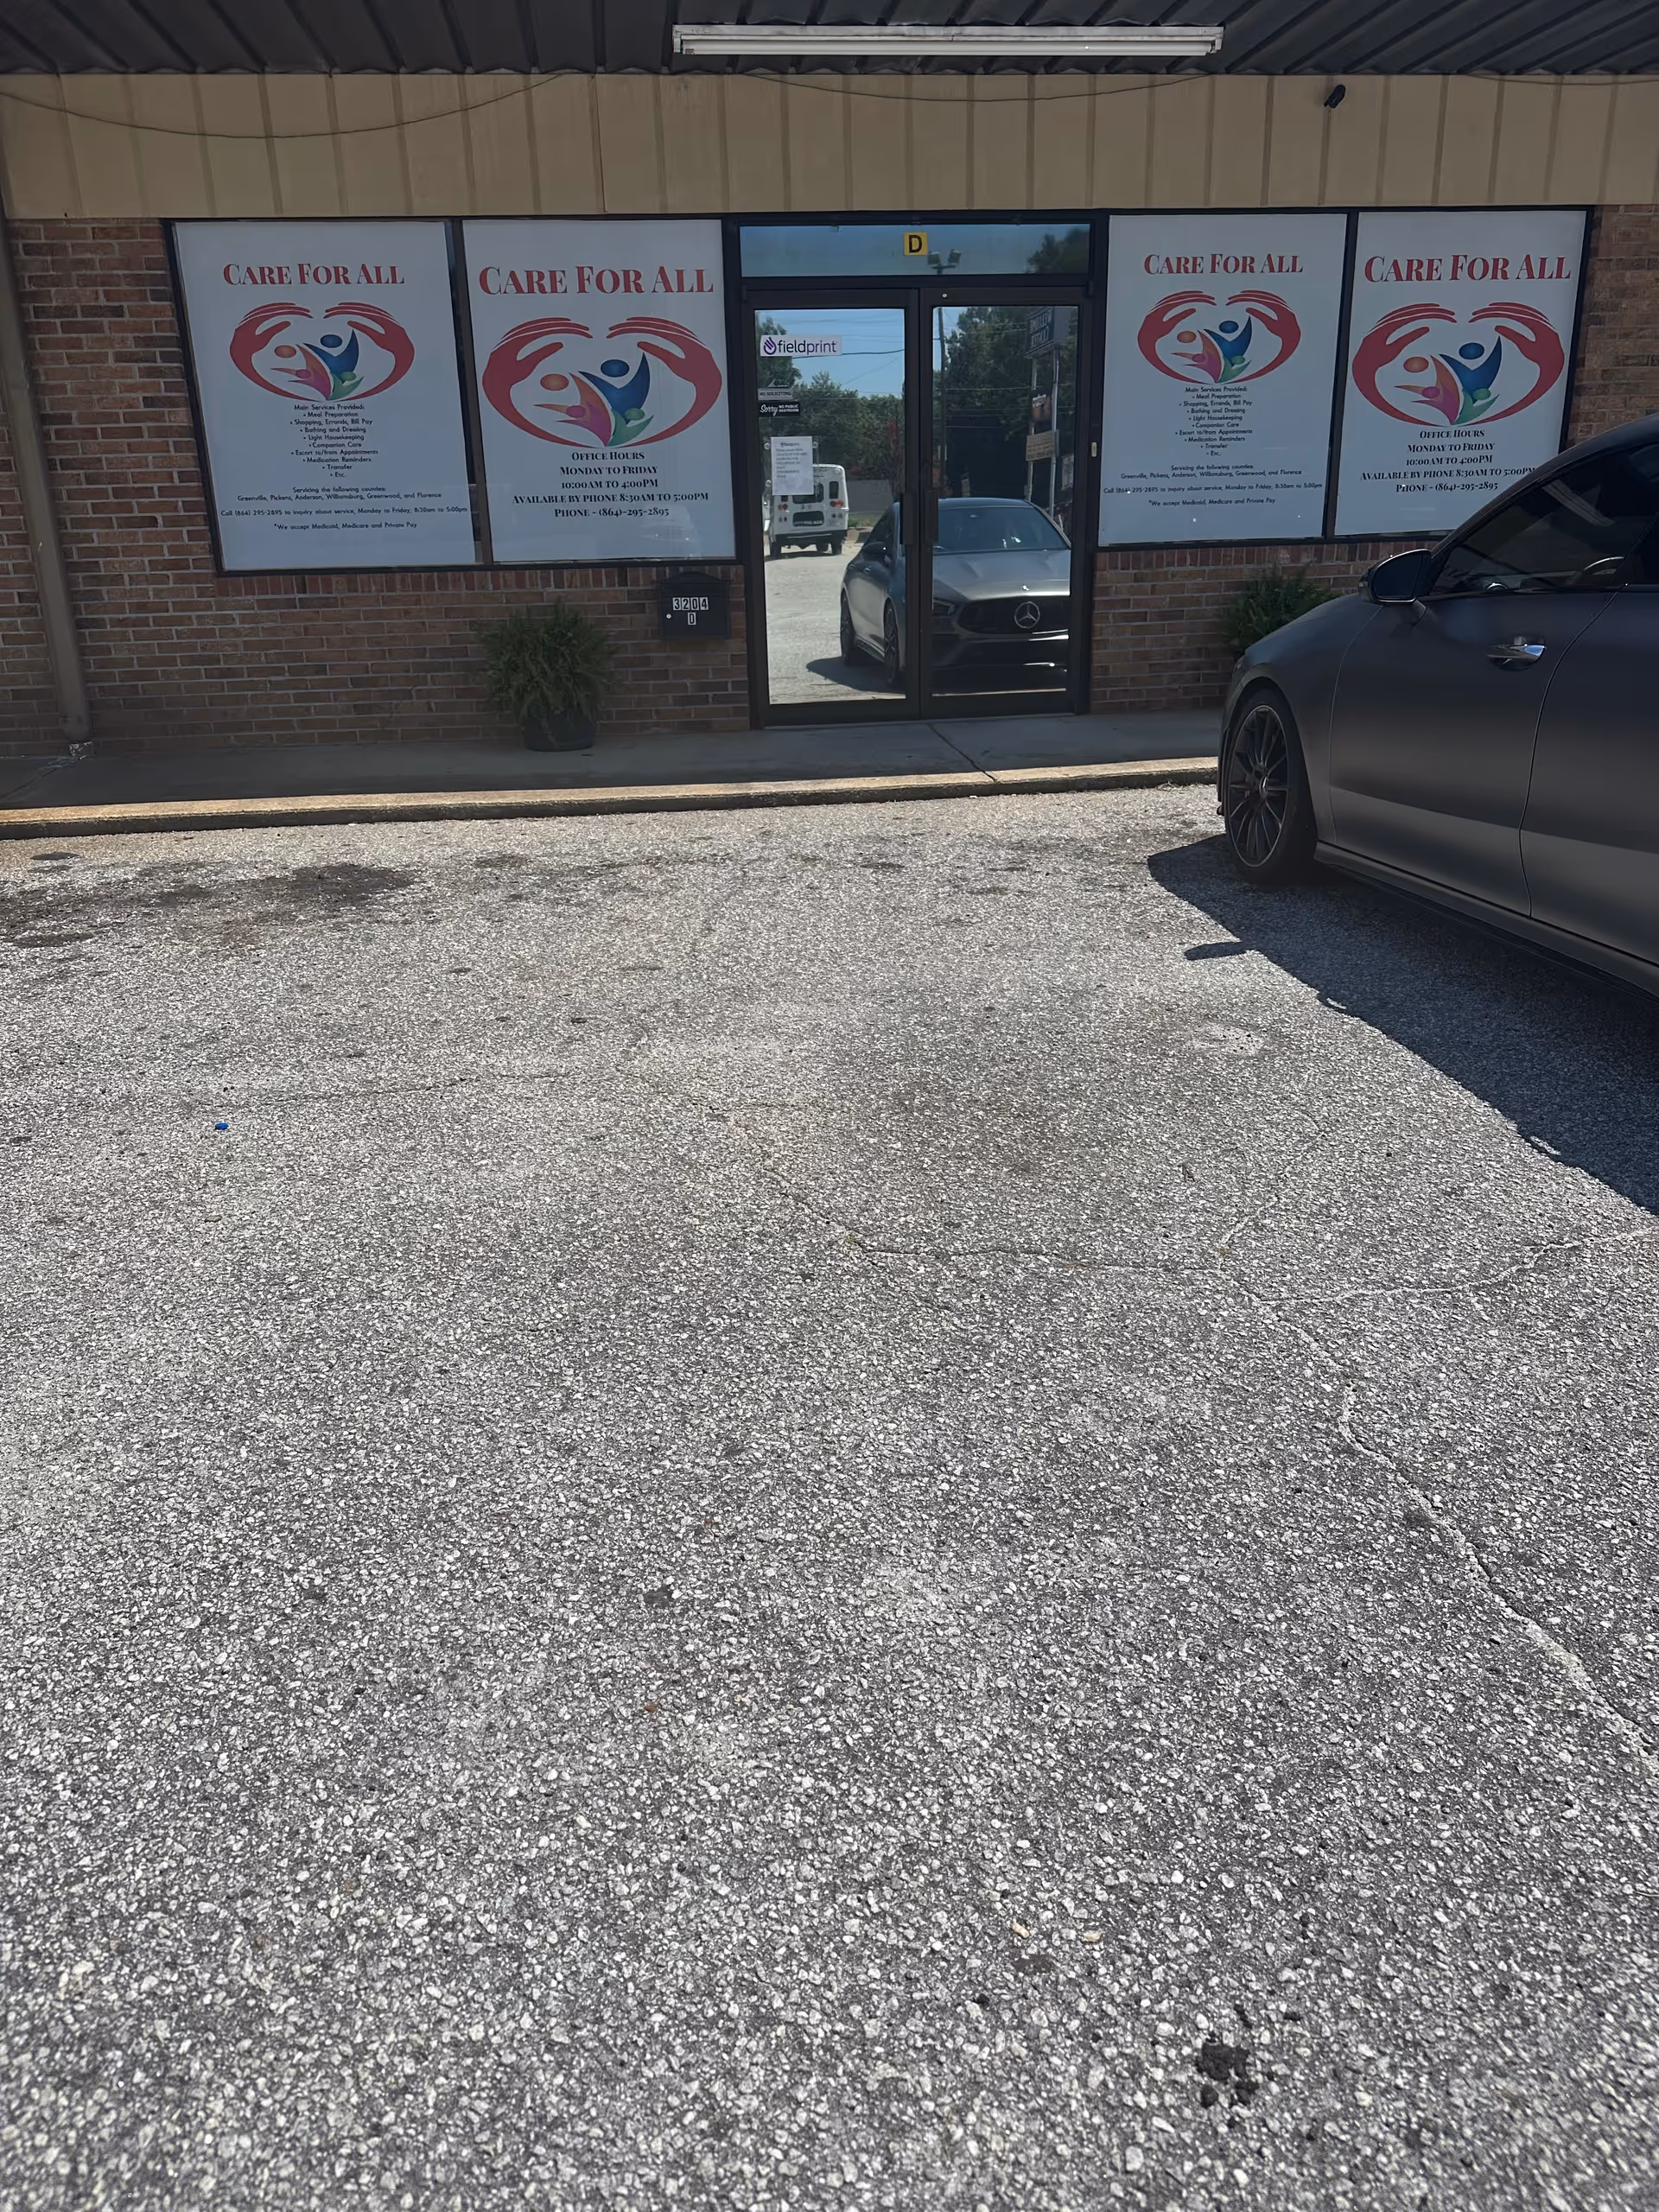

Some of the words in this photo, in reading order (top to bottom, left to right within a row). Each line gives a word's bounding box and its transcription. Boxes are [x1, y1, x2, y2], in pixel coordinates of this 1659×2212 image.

[909, 235, 922, 253] D
[1144, 254, 1204, 275] CARE
[1210, 254, 1255, 274] FOR
[1260, 253, 1303, 273] ALL
[1365, 257, 1442, 283] CARE
[1449, 255, 1510, 281] FOR
[1515, 254, 1571, 279] ALL
[224, 264, 291, 285] CARE
[297, 264, 351, 284] FOR
[357, 264, 404, 284] ALL
[480, 267, 567, 295] CARE
[575, 266, 645, 294] FOR
[652, 266, 713, 293] ALL
[778, 340, 836, 355] fieldprint
[760, 404, 778, 416] Sorry
[1459, 454, 1492, 465] 4:00PM
[1456, 468, 1487, 478] 8:30AM
[621, 479, 658, 489] 4:00PM
[1435, 481, 1497, 492] (864)-295-2895
[620, 493, 654, 503] 8:30AM
[673, 493, 708, 501] 5:00PM
[599, 507, 669, 517] (864)-295-2895
[674, 598, 708, 610] 3204
